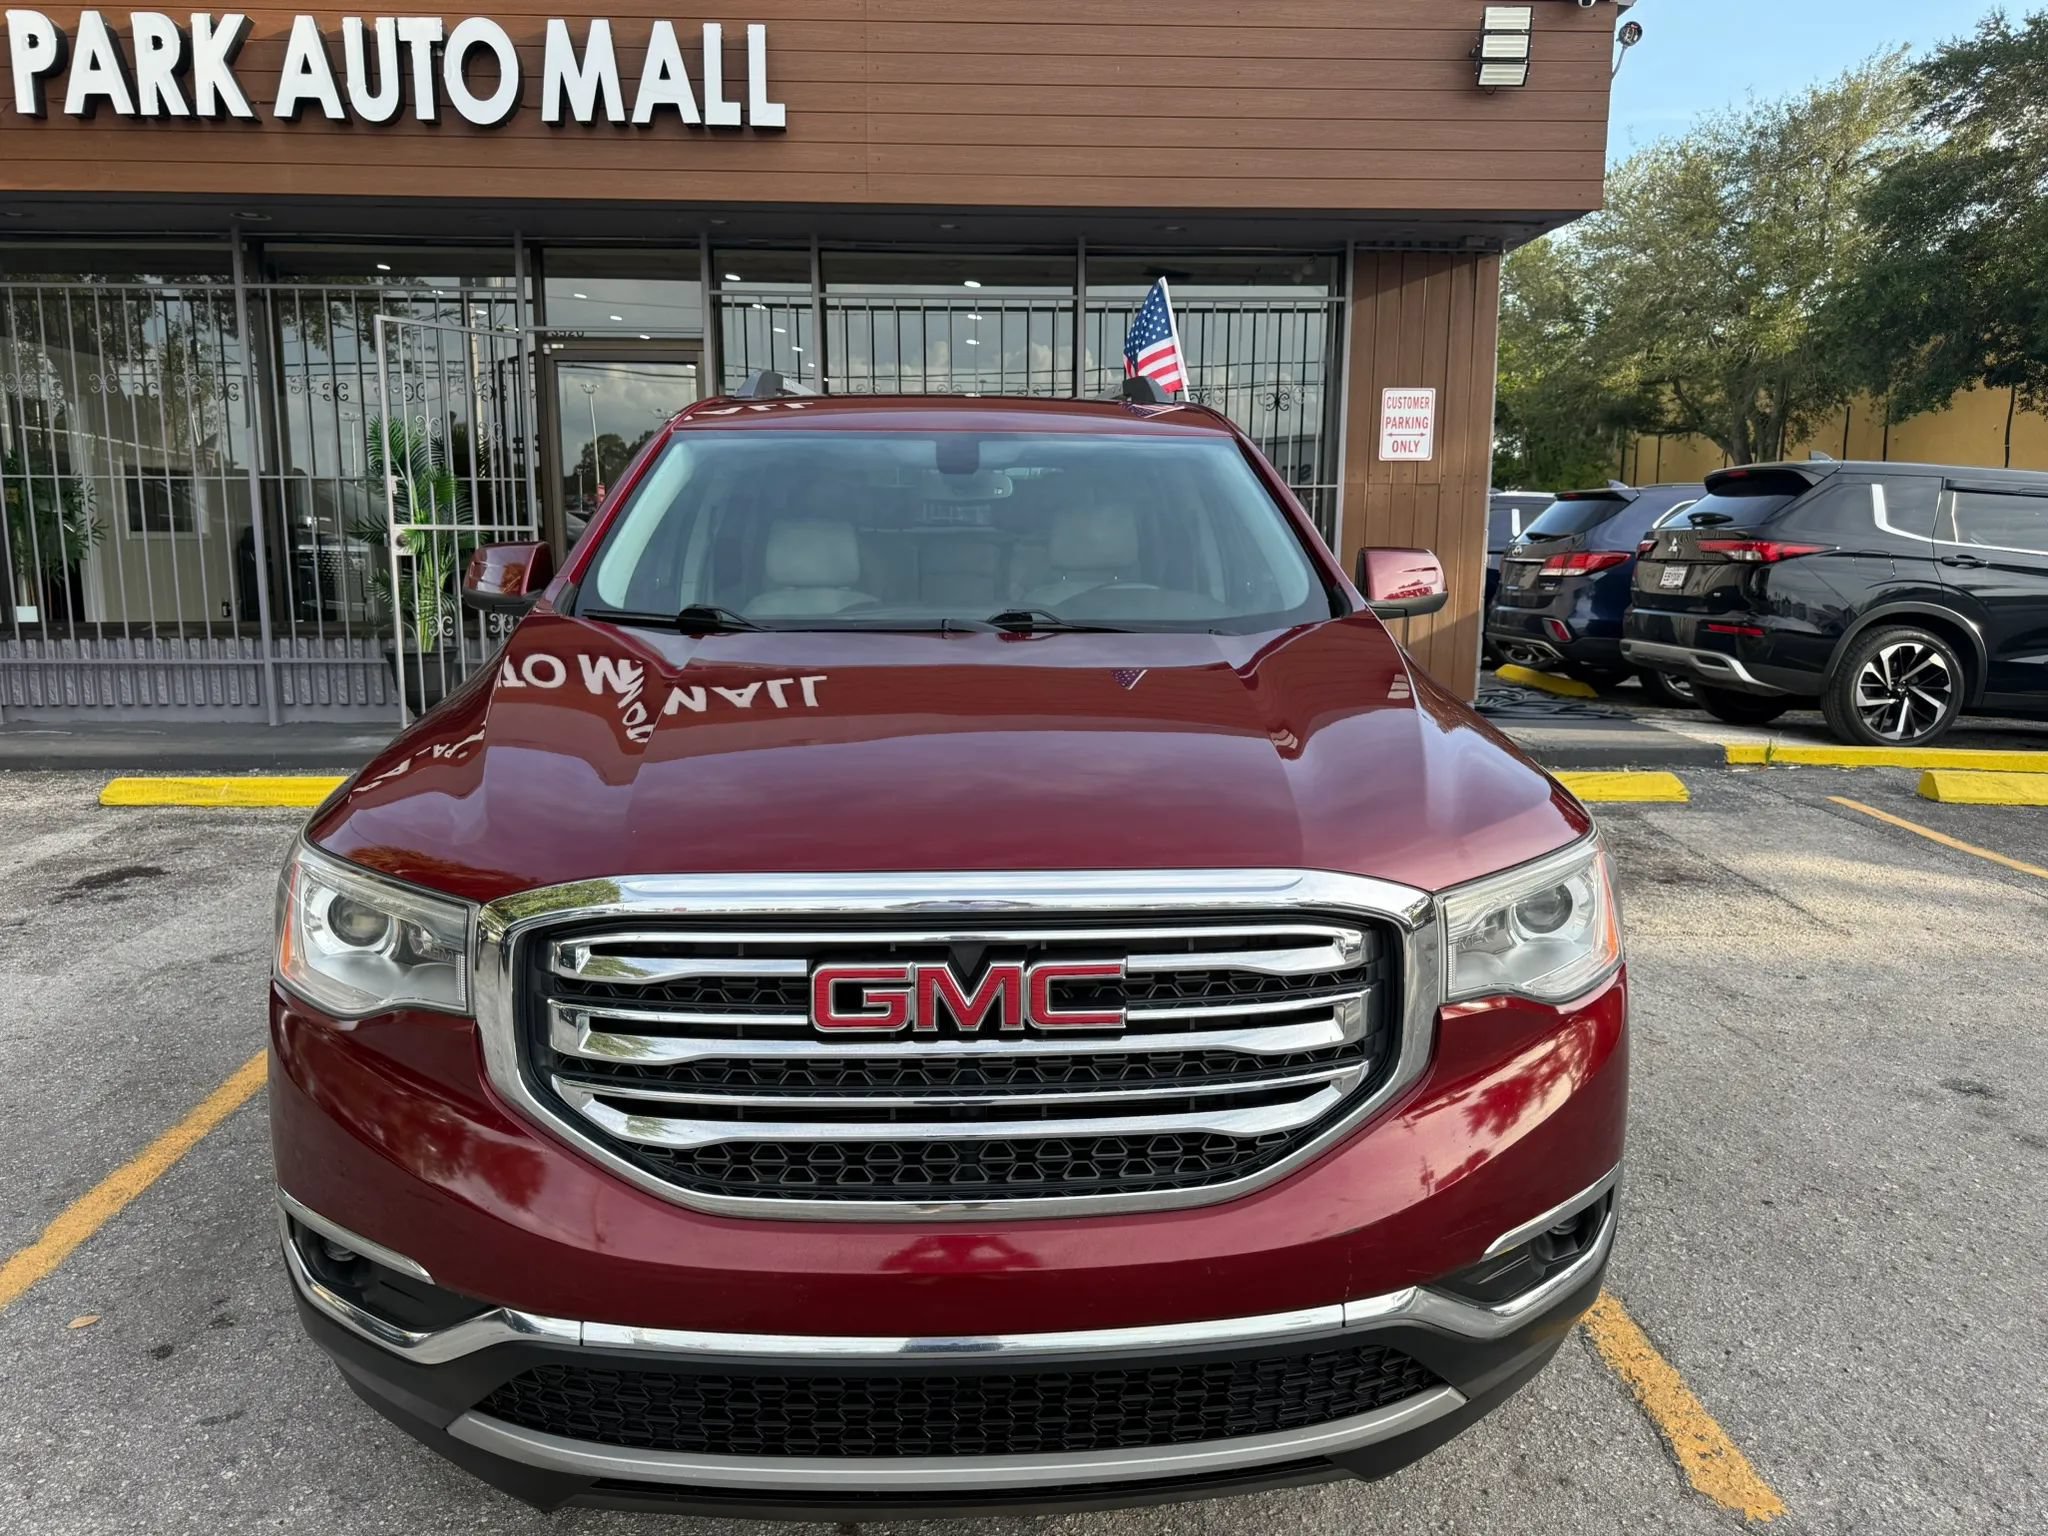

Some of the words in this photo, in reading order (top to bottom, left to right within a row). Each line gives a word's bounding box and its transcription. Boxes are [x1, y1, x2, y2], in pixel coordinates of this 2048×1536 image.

[7, 9, 255, 119] PARK
[274, 15, 521, 126] AUTO
[541, 18, 786, 128] MALL
[1386, 396, 1430, 409] CUSTOMER
[1385, 416, 1429, 430] PARKING
[1391, 440, 1420, 453] ONLY
[811, 960, 1128, 1033] GMC
